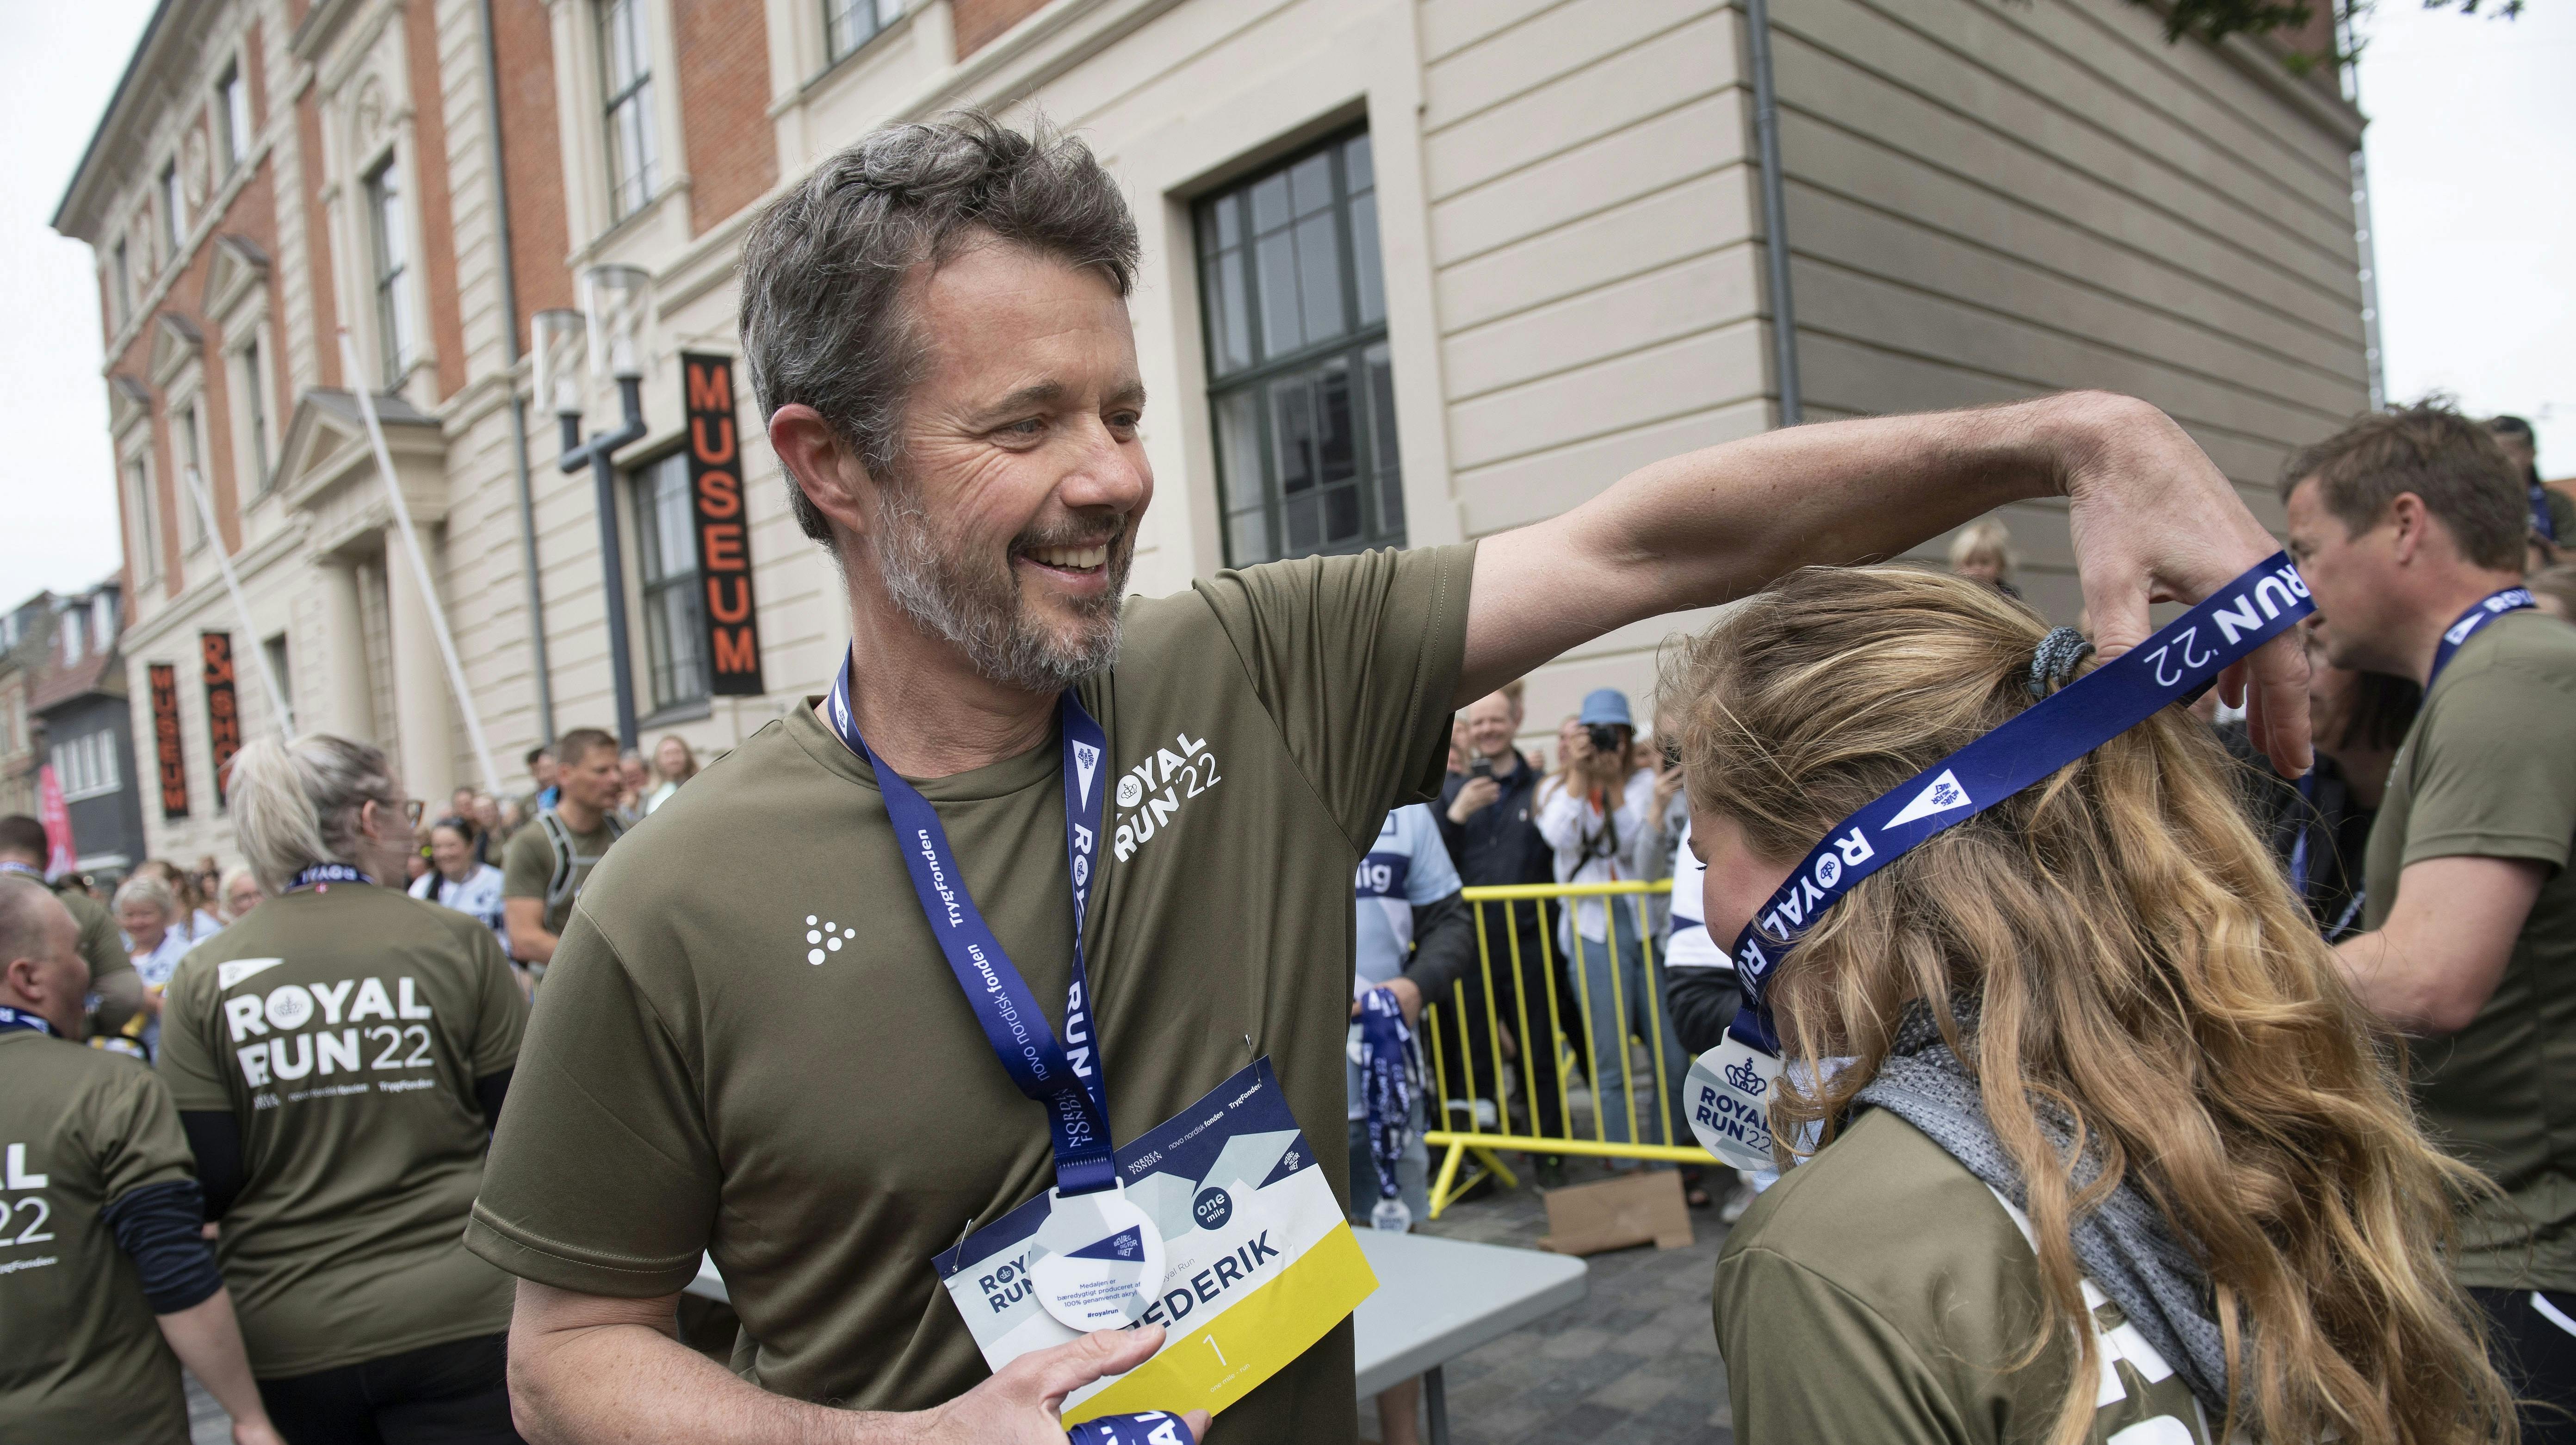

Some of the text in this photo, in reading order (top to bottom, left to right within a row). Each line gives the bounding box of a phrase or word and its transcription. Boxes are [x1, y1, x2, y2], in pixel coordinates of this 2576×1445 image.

[688, 362, 756, 674] MUSEUM
[150, 666, 187, 809] MUSEUM
[1116, 732, 1207, 823] OYAL
[1931, 794, 1944, 805] FOR
[1941, 789, 1959, 806] BEVÆG
[1762, 826, 1876, 941] ROYAL
[917, 829, 1051, 1082] novo nordisk fonden TrygFonden
[224, 976, 433, 1043] ROYAL
[377, 1078, 435, 1093] TrygFonden
[1228, 1083, 1263, 1110] TrygFonden
[1168, 1110, 1224, 1150] novo nordisk fonden
[1284, 1151, 1294, 1166] BEVÆG
[1288, 1160, 1298, 1171] LIVET
[1197, 1192, 1226, 1216] one
[1206, 1207, 1226, 1223] mile
[1114, 1235, 1132, 1247] BEVÆG
[1127, 1239, 1138, 1247] FOR
[1117, 1247, 1133, 1257] LIVET
[978, 1251, 1031, 1295] ROY
[1178, 1258, 1195, 1272] Run
[1079, 1280, 1108, 1290] Medaljen
[1115, 1229, 1280, 1331] EDERIK
[1057, 1290, 1097, 1301] bæredygtigt
[1098, 1283, 1133, 1295] produceret
[1083, 1293, 1121, 1306] genanvendt
[1121, 1290, 1137, 1298] akryl
[1087, 1308, 1119, 1318] #royalrun
[1203, 1334, 1226, 1366] 1
[1210, 1382, 1222, 1392] one
[1222, 1373, 1235, 1384] mile
[1239, 1363, 1251, 1372] run
